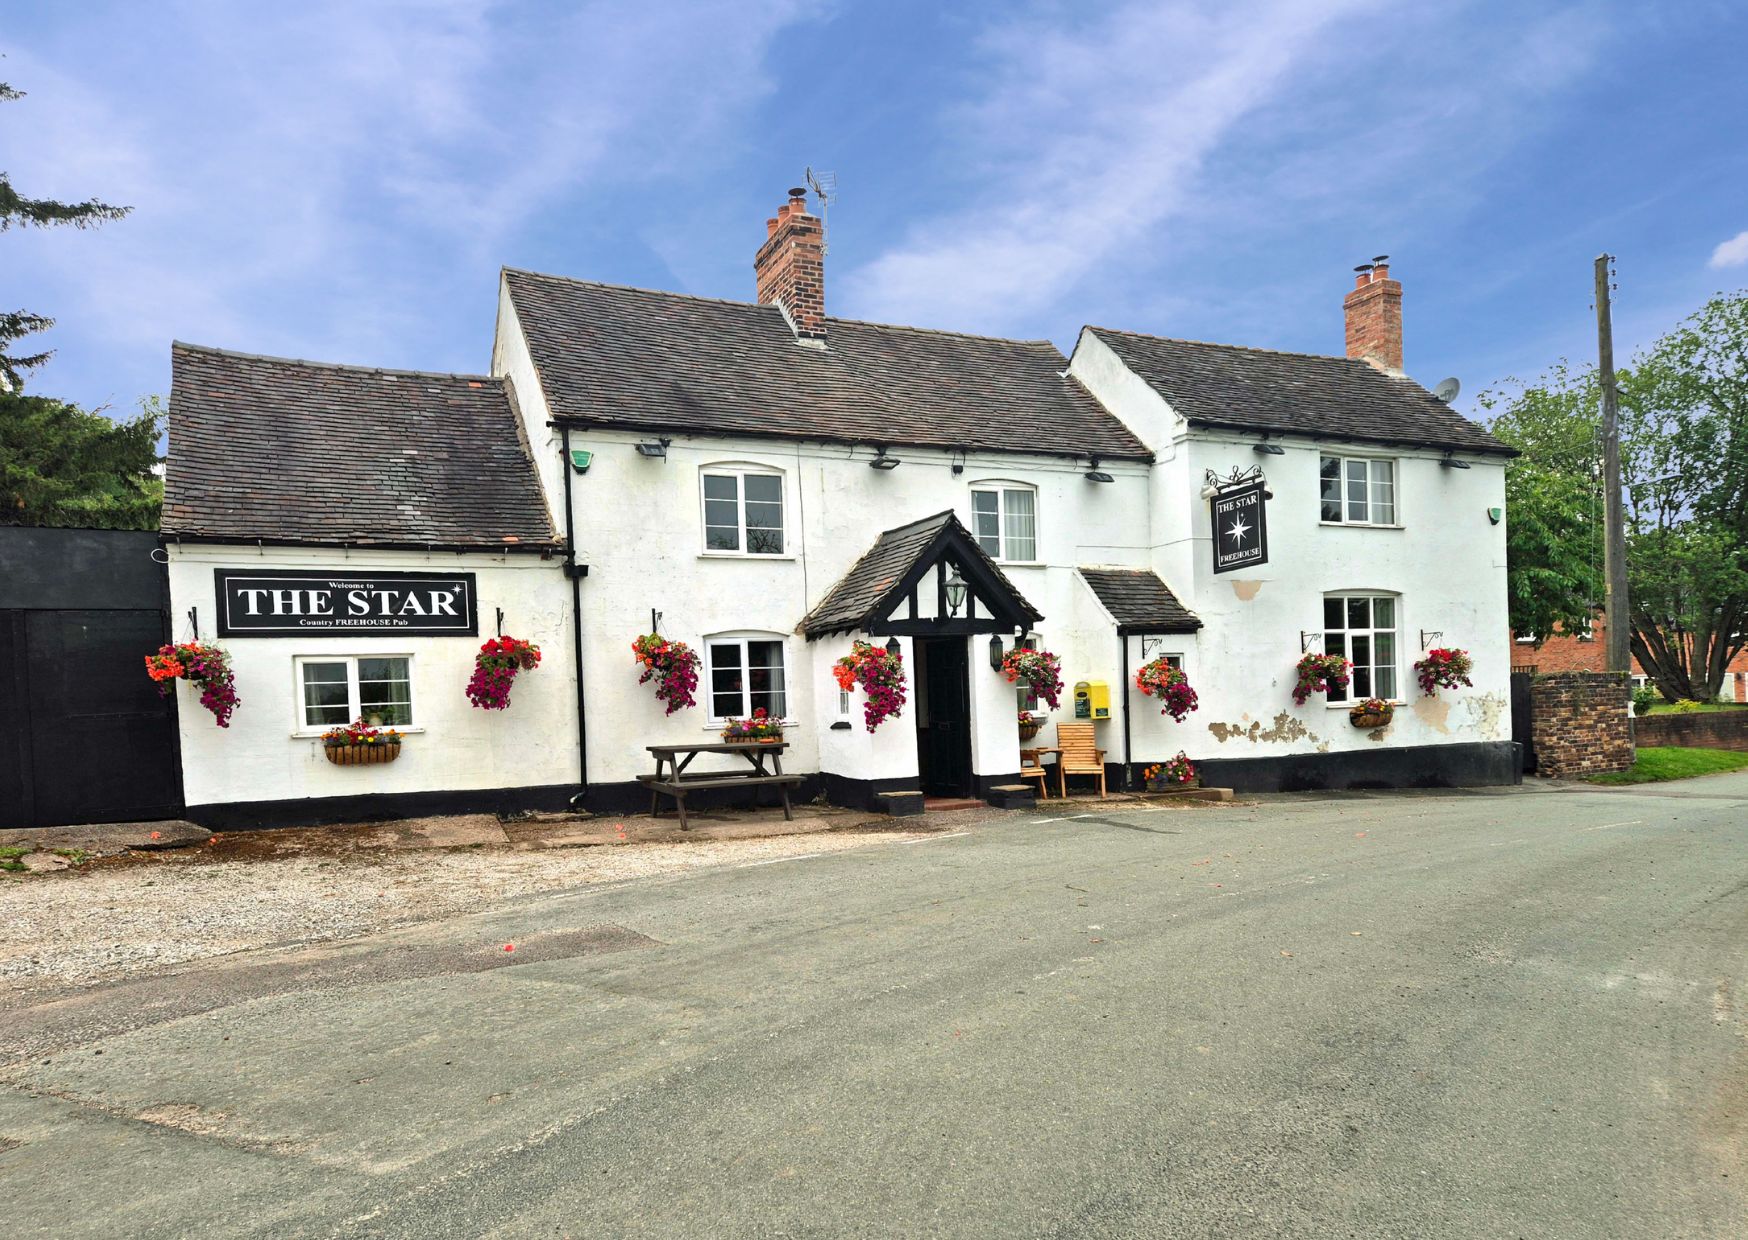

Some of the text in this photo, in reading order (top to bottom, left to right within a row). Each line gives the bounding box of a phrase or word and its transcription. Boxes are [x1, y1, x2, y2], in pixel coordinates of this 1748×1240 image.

[1218, 495, 1257, 514] THE STAR
[1220, 547, 1260, 563] FREEHOUSE
[328, 581, 365, 589] Welcome
[237, 589, 459, 616] THE STAR
[299, 618, 409, 627] Country FREEHOUSE Pub
